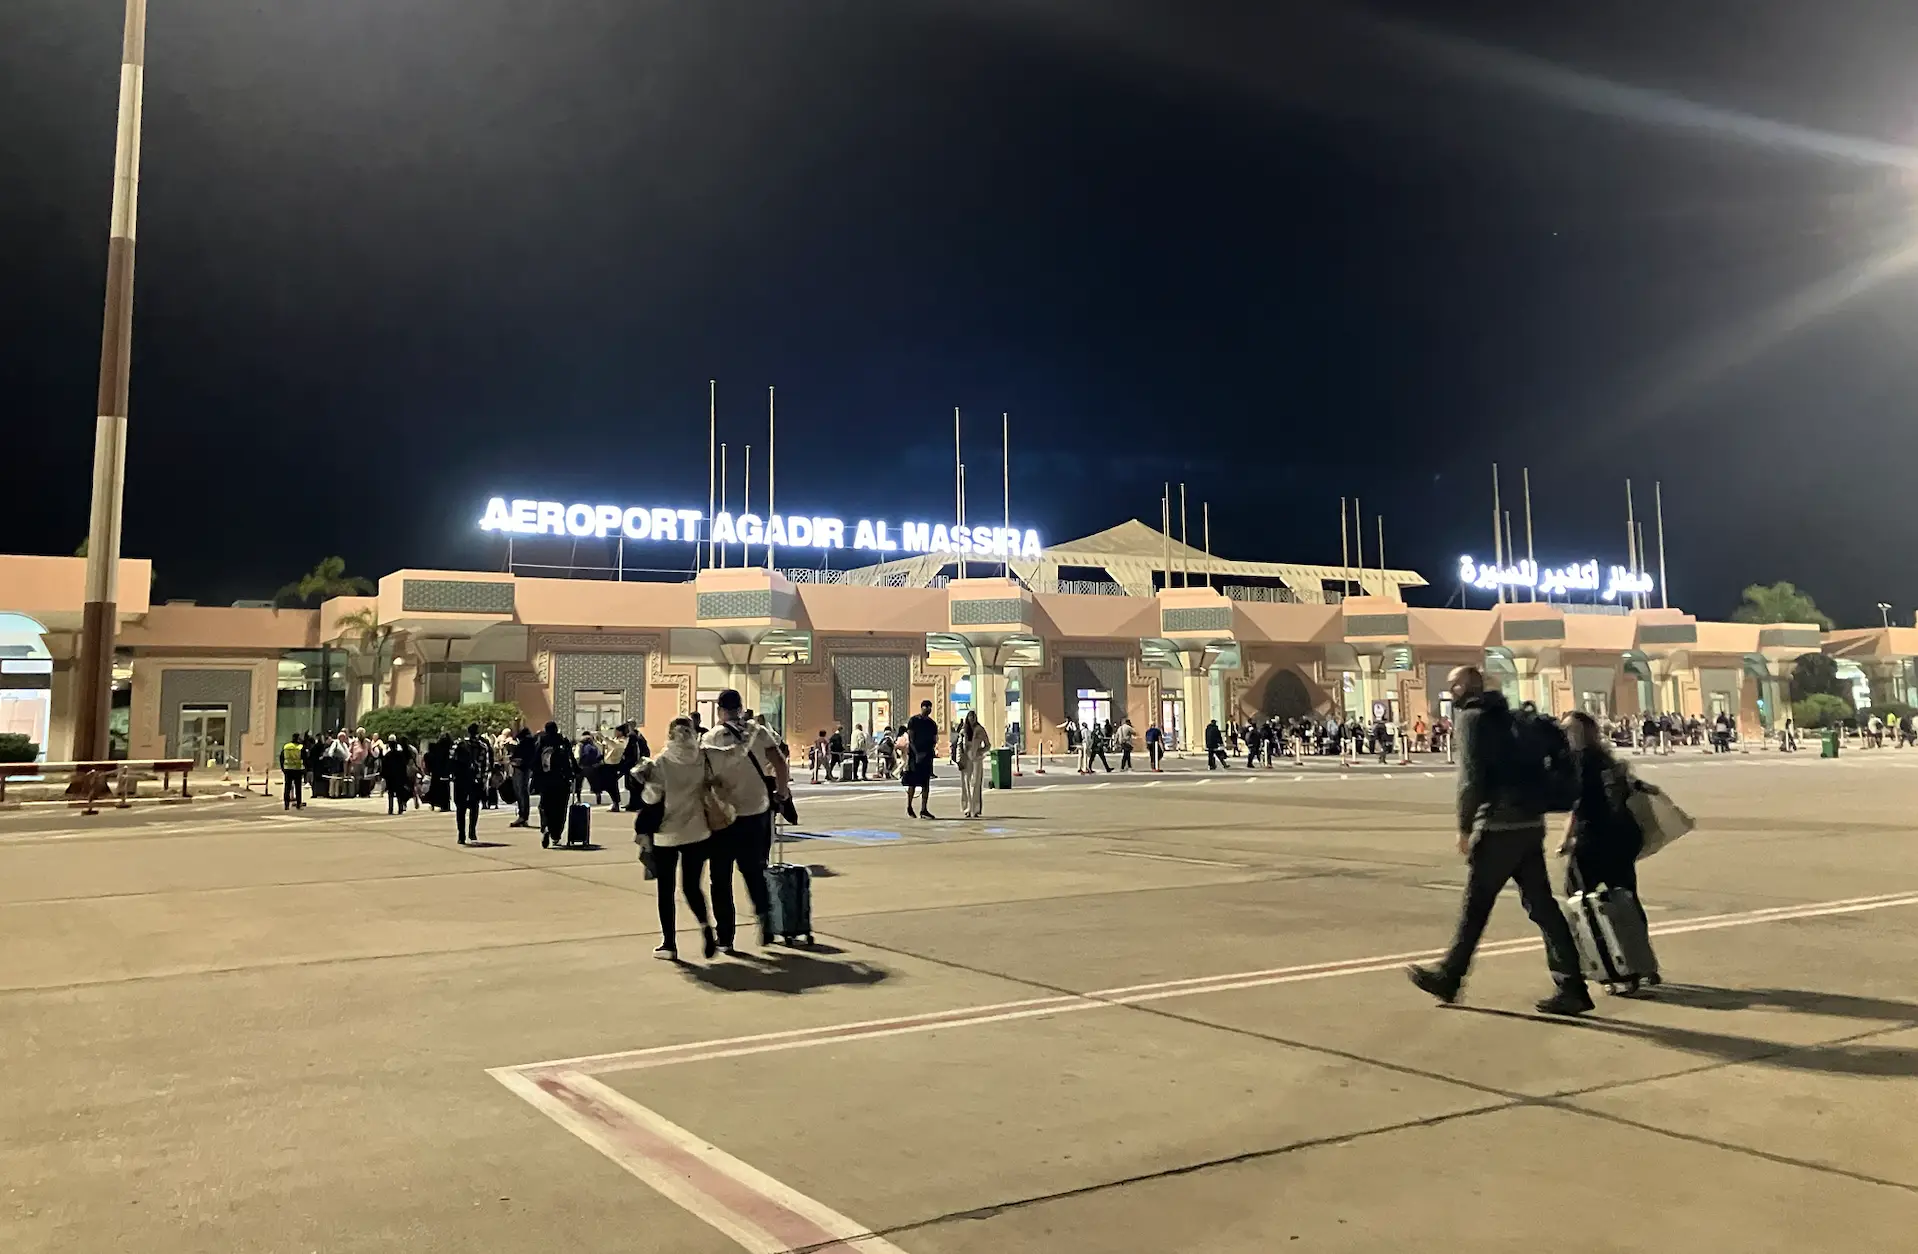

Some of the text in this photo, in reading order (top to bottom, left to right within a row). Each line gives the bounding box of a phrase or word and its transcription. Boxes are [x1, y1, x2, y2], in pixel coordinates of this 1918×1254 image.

[480, 497, 1042, 557] AEROPORT AGADIR AL MASSIRA
